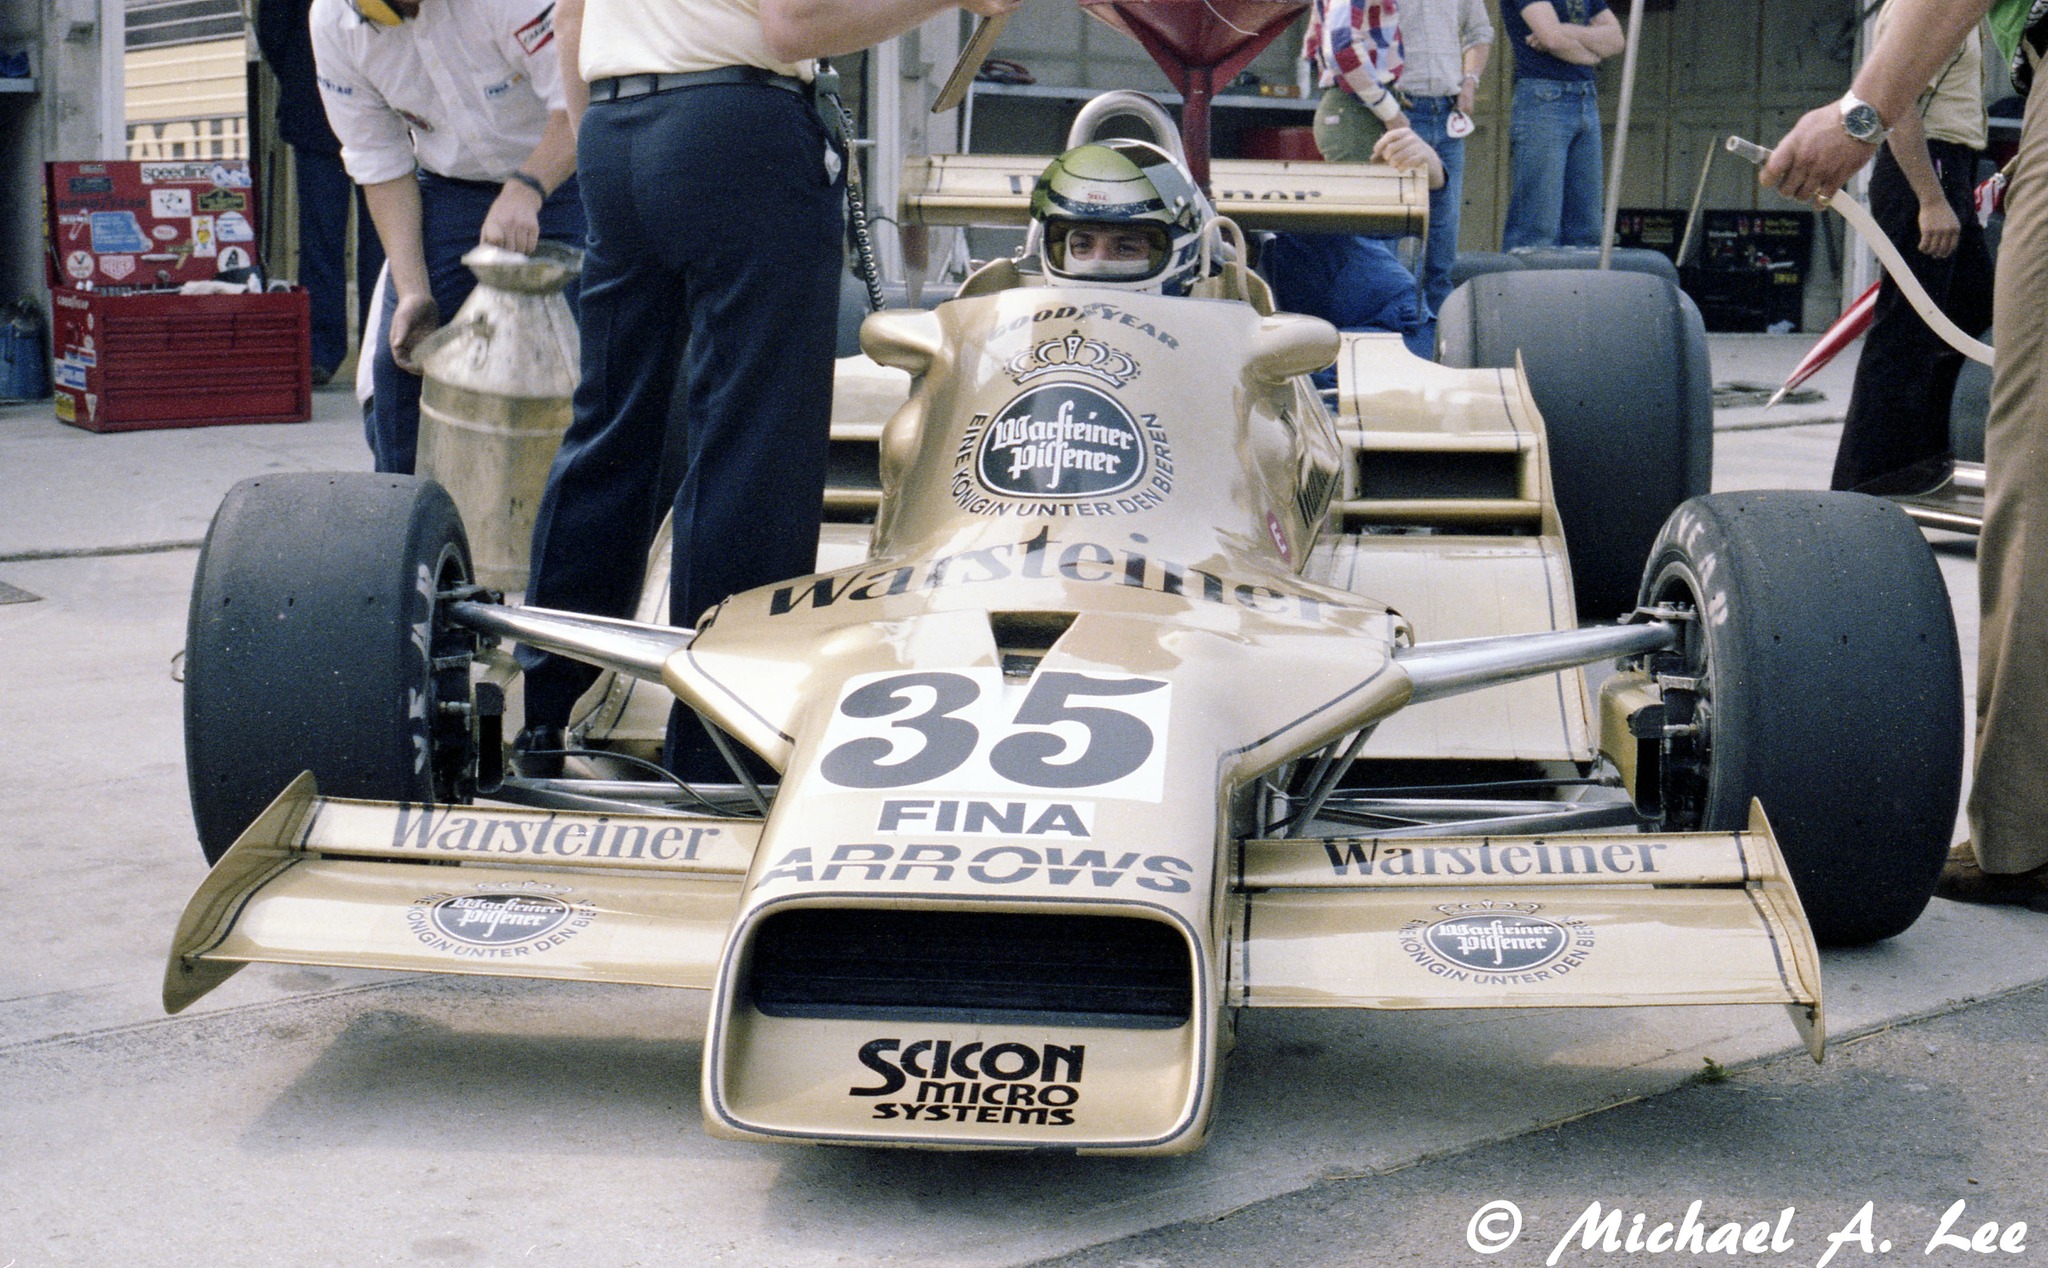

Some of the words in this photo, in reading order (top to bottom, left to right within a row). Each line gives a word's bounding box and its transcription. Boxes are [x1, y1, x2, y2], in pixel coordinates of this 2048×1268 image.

[988, 303, 1180, 350] GOODYEAR
[954, 412, 989, 467] EINE
[991, 400, 1135, 451] Warsteiner
[1140, 412, 1174, 495] BIEREN
[951, 466, 1013, 516] KÖNIGIN
[1014, 503, 1116, 516] UNTER
[1115, 488, 1164, 514] DEN
[769, 525, 1345, 622] Warsteiner
[820, 671, 1170, 789] 35
[392, 803, 720, 860] Warsteiner
[877, 800, 1090, 838] FINA
[752, 844, 1194, 894] ARROWS
[1324, 837, 1667, 876] Warsteiner
[454, 946, 529, 958] UNTER
[533, 929, 577, 952] DEN
[1473, 971, 1554, 985] UNTER
[1551, 948, 1590, 976] DEN
[849, 1038, 1085, 1096] SCICON
[872, 1103, 1076, 1126] SYSTEMS
[916, 1081, 1079, 1107] MICRO
